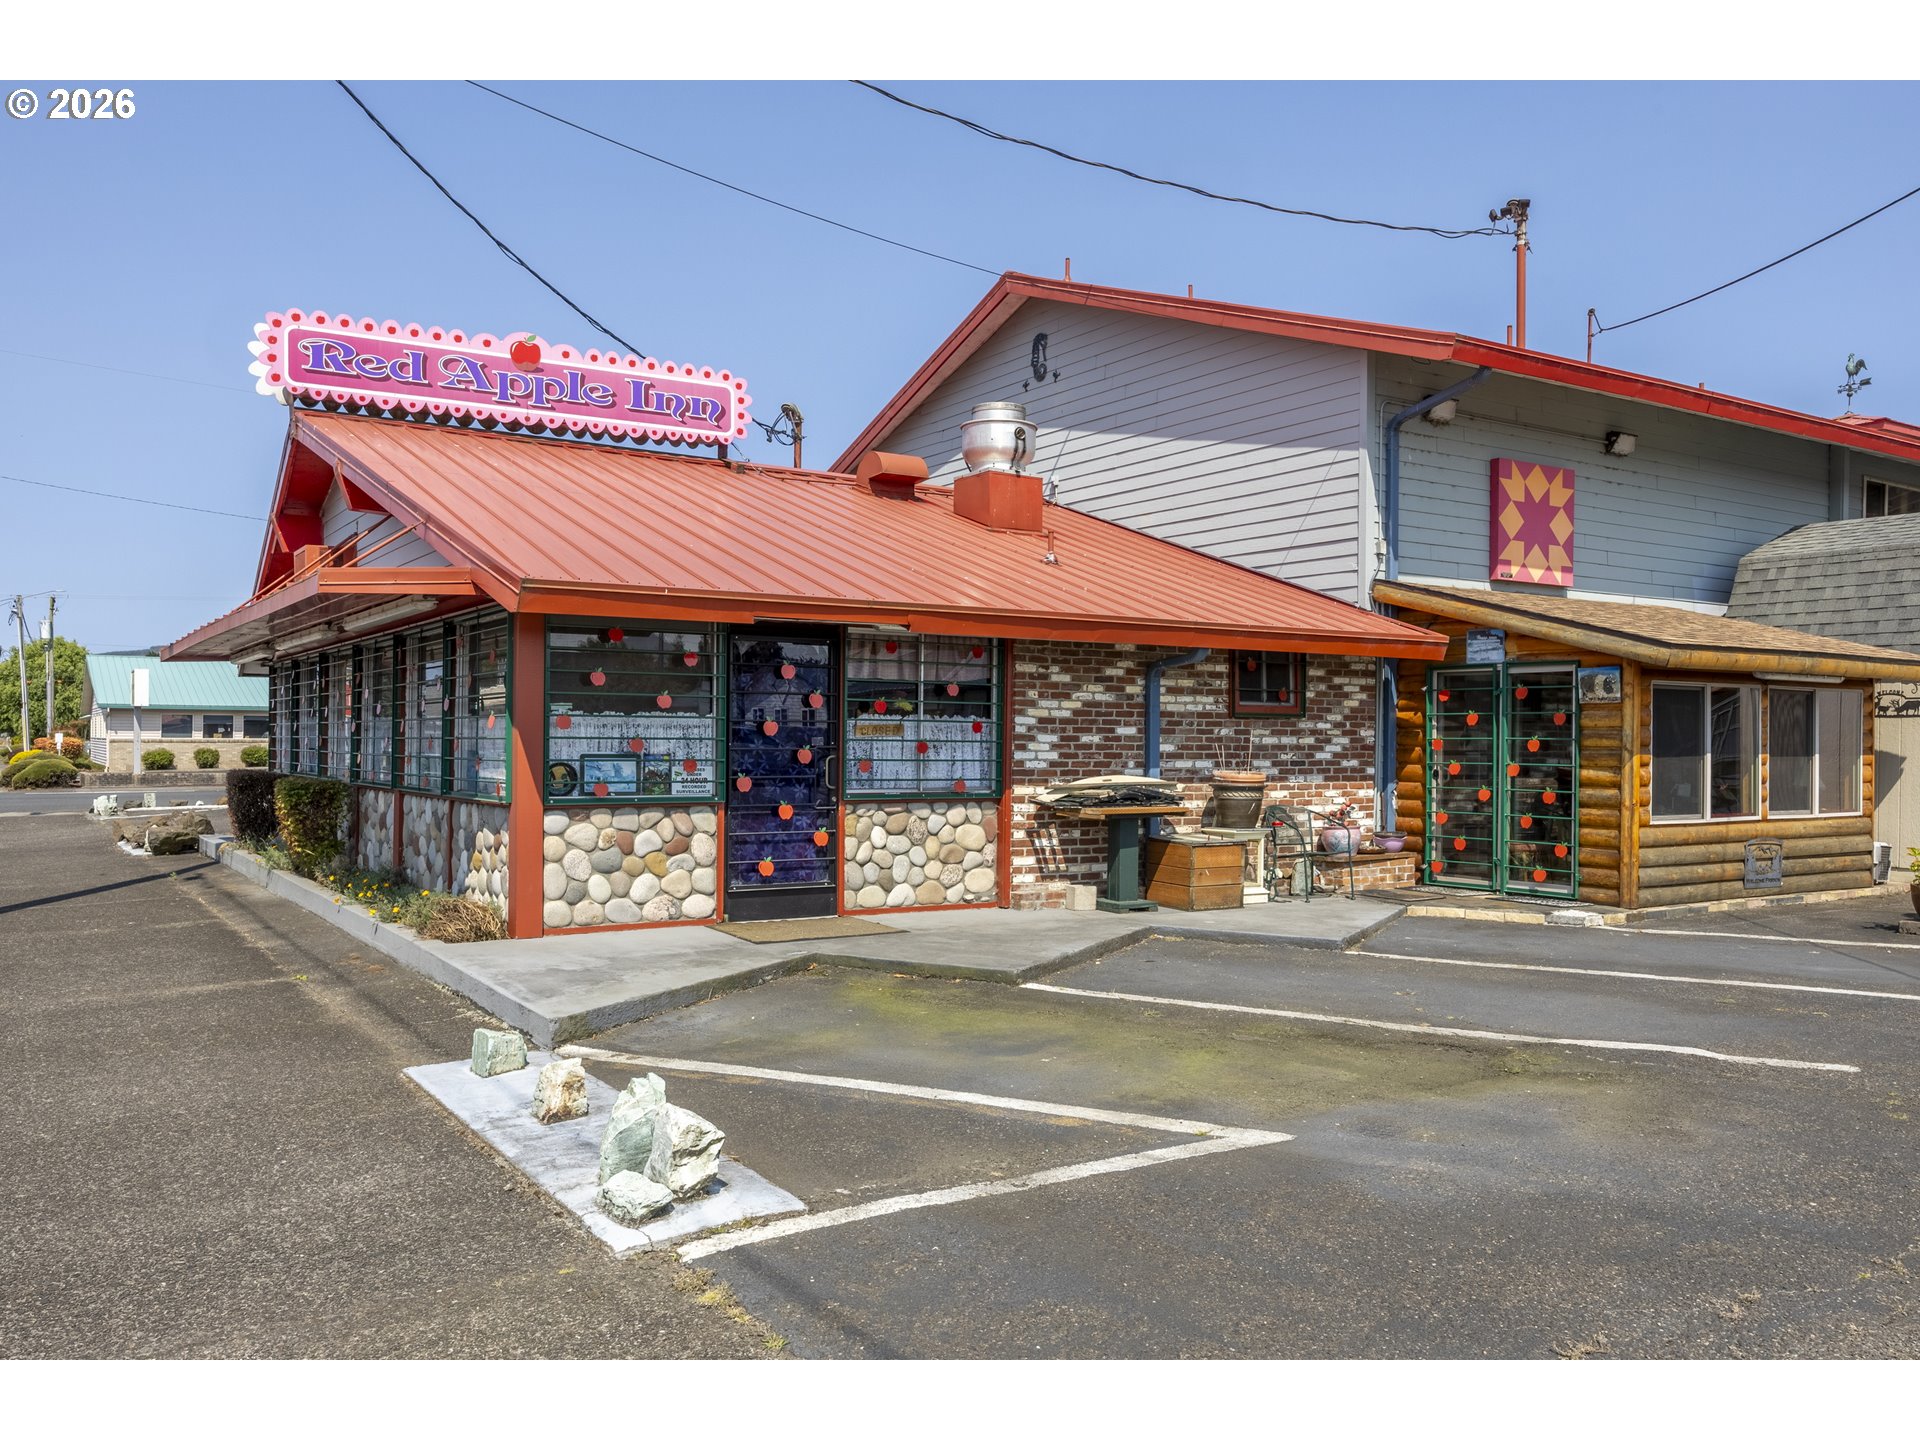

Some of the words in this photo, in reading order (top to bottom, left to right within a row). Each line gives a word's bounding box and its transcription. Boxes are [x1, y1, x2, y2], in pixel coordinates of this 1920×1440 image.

[298, 338, 429, 384] Red
[438, 355, 614, 408] Apple
[625, 377, 722, 426] Inn
[860, 726, 900, 736] CLOSED
